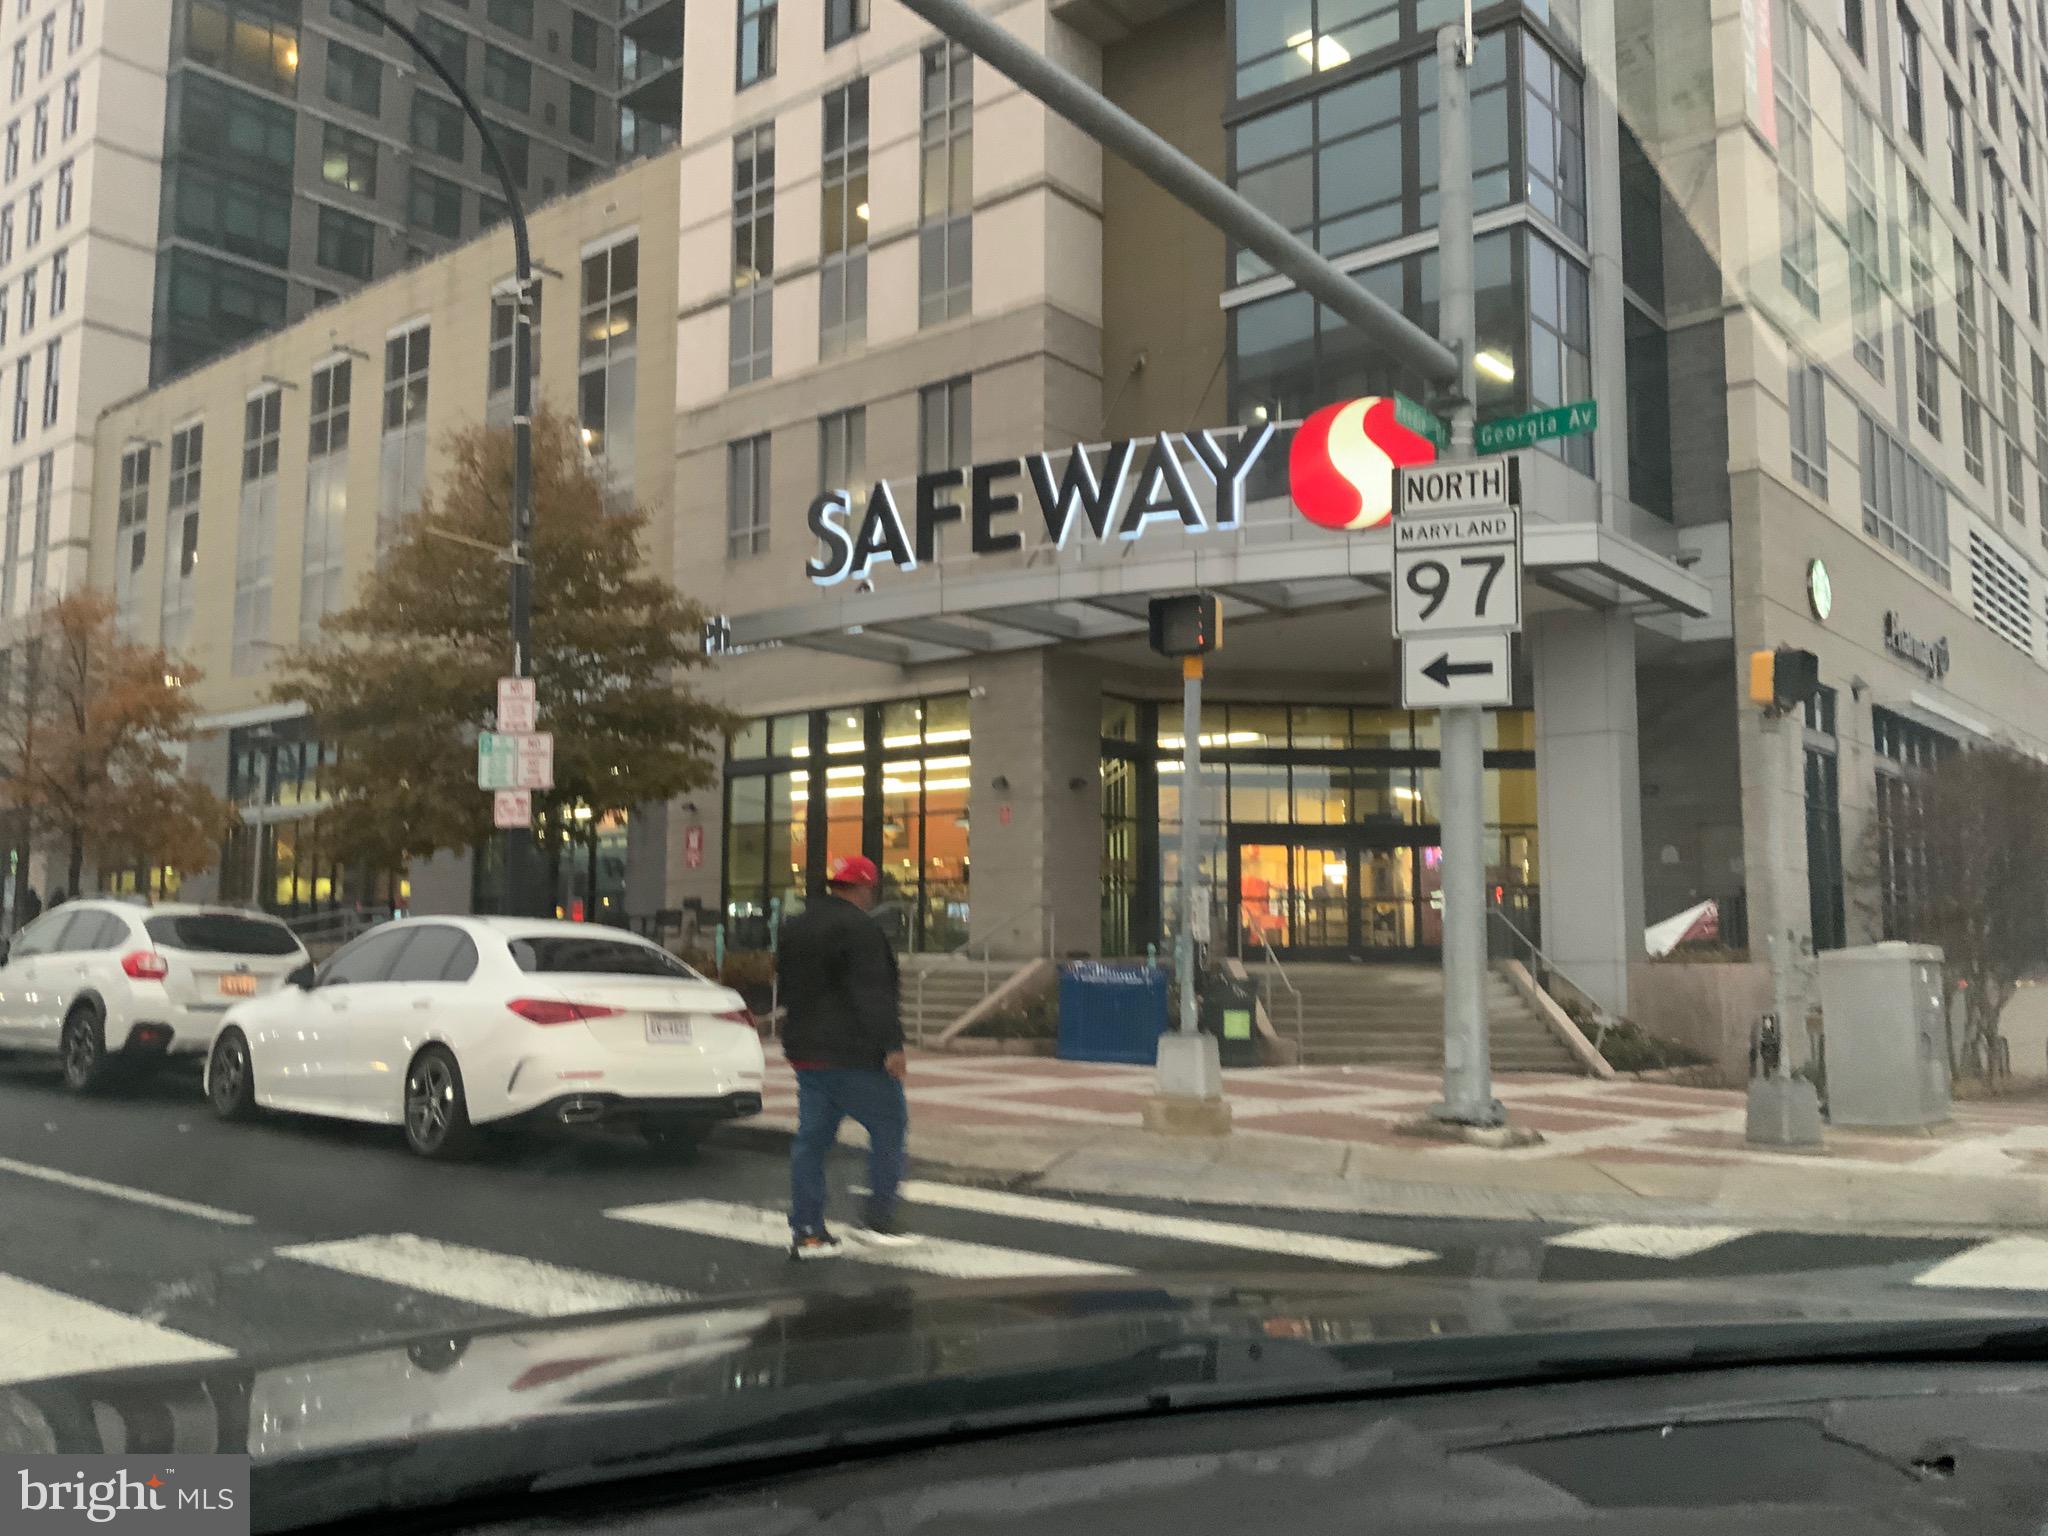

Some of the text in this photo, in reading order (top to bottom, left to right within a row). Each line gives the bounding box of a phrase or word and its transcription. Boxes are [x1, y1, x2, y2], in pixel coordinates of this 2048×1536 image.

[1482, 407, 1592, 446] Georgia Av
[805, 422, 1276, 587] SAFEWAY
[1406, 468, 1501, 504] NORTH
[1401, 519, 1507, 542] MARYLAND
[1406, 555, 1506, 622] 97
